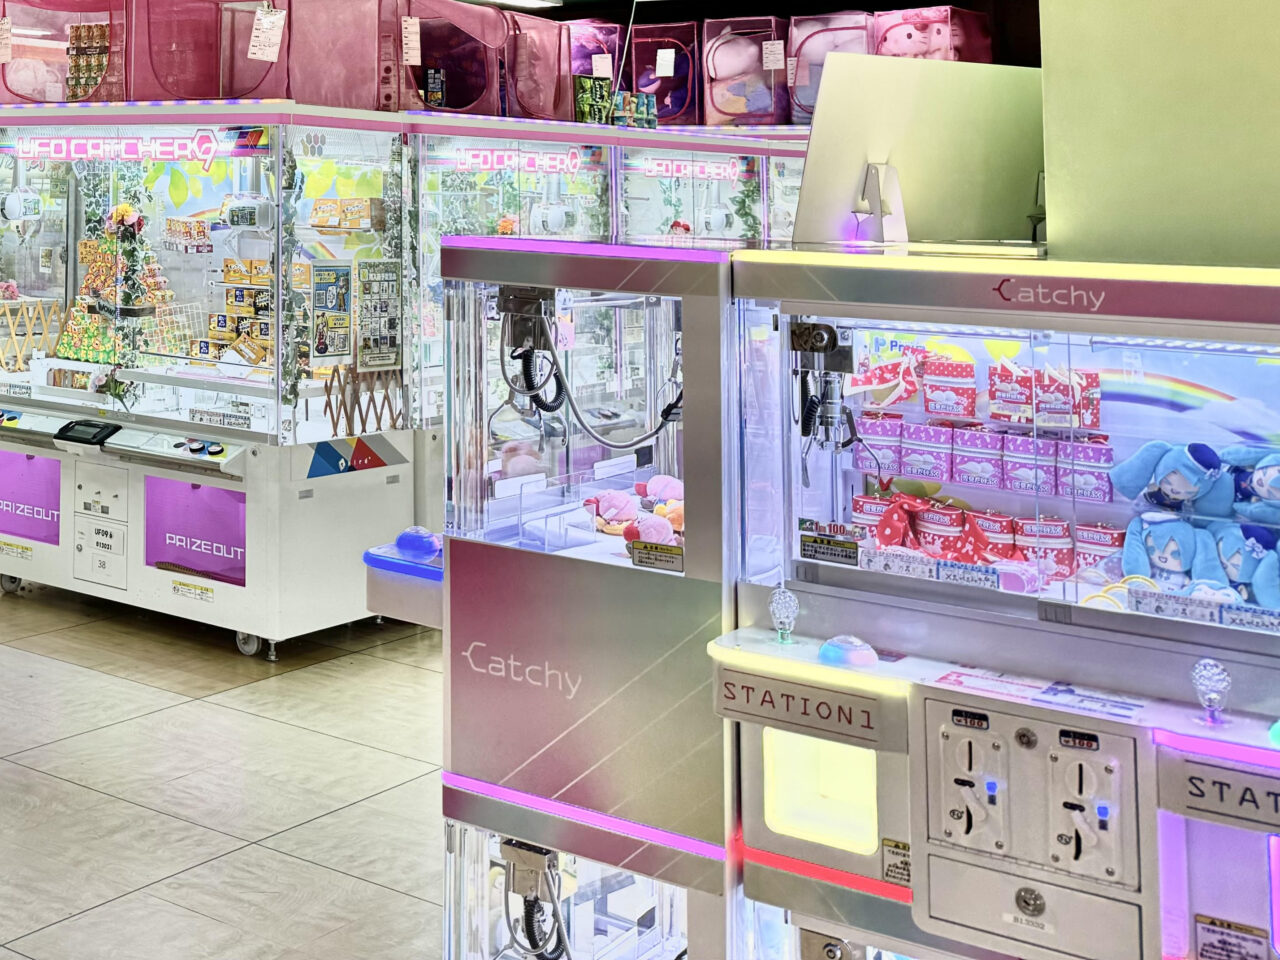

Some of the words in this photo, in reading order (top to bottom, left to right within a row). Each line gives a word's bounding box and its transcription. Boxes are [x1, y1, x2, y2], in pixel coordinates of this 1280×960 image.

[18, 138, 68, 159] UFO
[992, 278, 1106, 311] Catchy
[97, 559, 107, 570] 38
[461, 641, 582, 700] Catchy
[723, 681, 876, 730] STATION1
